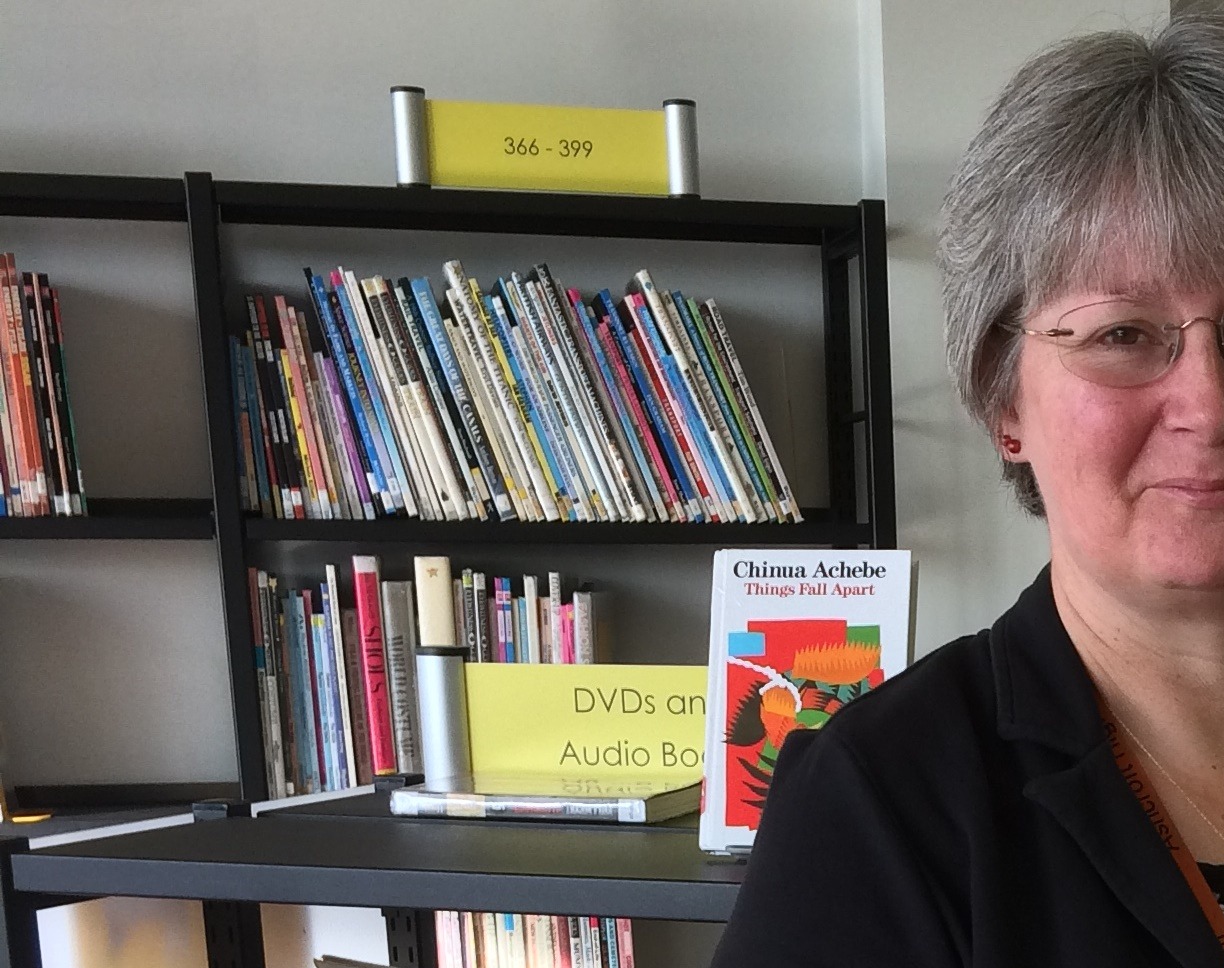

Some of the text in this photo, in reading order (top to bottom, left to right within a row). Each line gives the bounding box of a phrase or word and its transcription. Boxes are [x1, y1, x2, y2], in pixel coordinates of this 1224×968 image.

[504, 136, 593, 159] 366 399
[531, 321, 558, 366] AIRWAYS
[710, 306, 739, 362] ROAD TRAVEL
[493, 366, 514, 410] TITANIC
[461, 403, 483, 444] CANALS
[733, 561, 886, 579] Chinua Achebe
[744, 583, 875, 597] Things Fall Apart
[574, 688, 706, 715] DVDs an
[559, 741, 705, 767] Audio Bo
